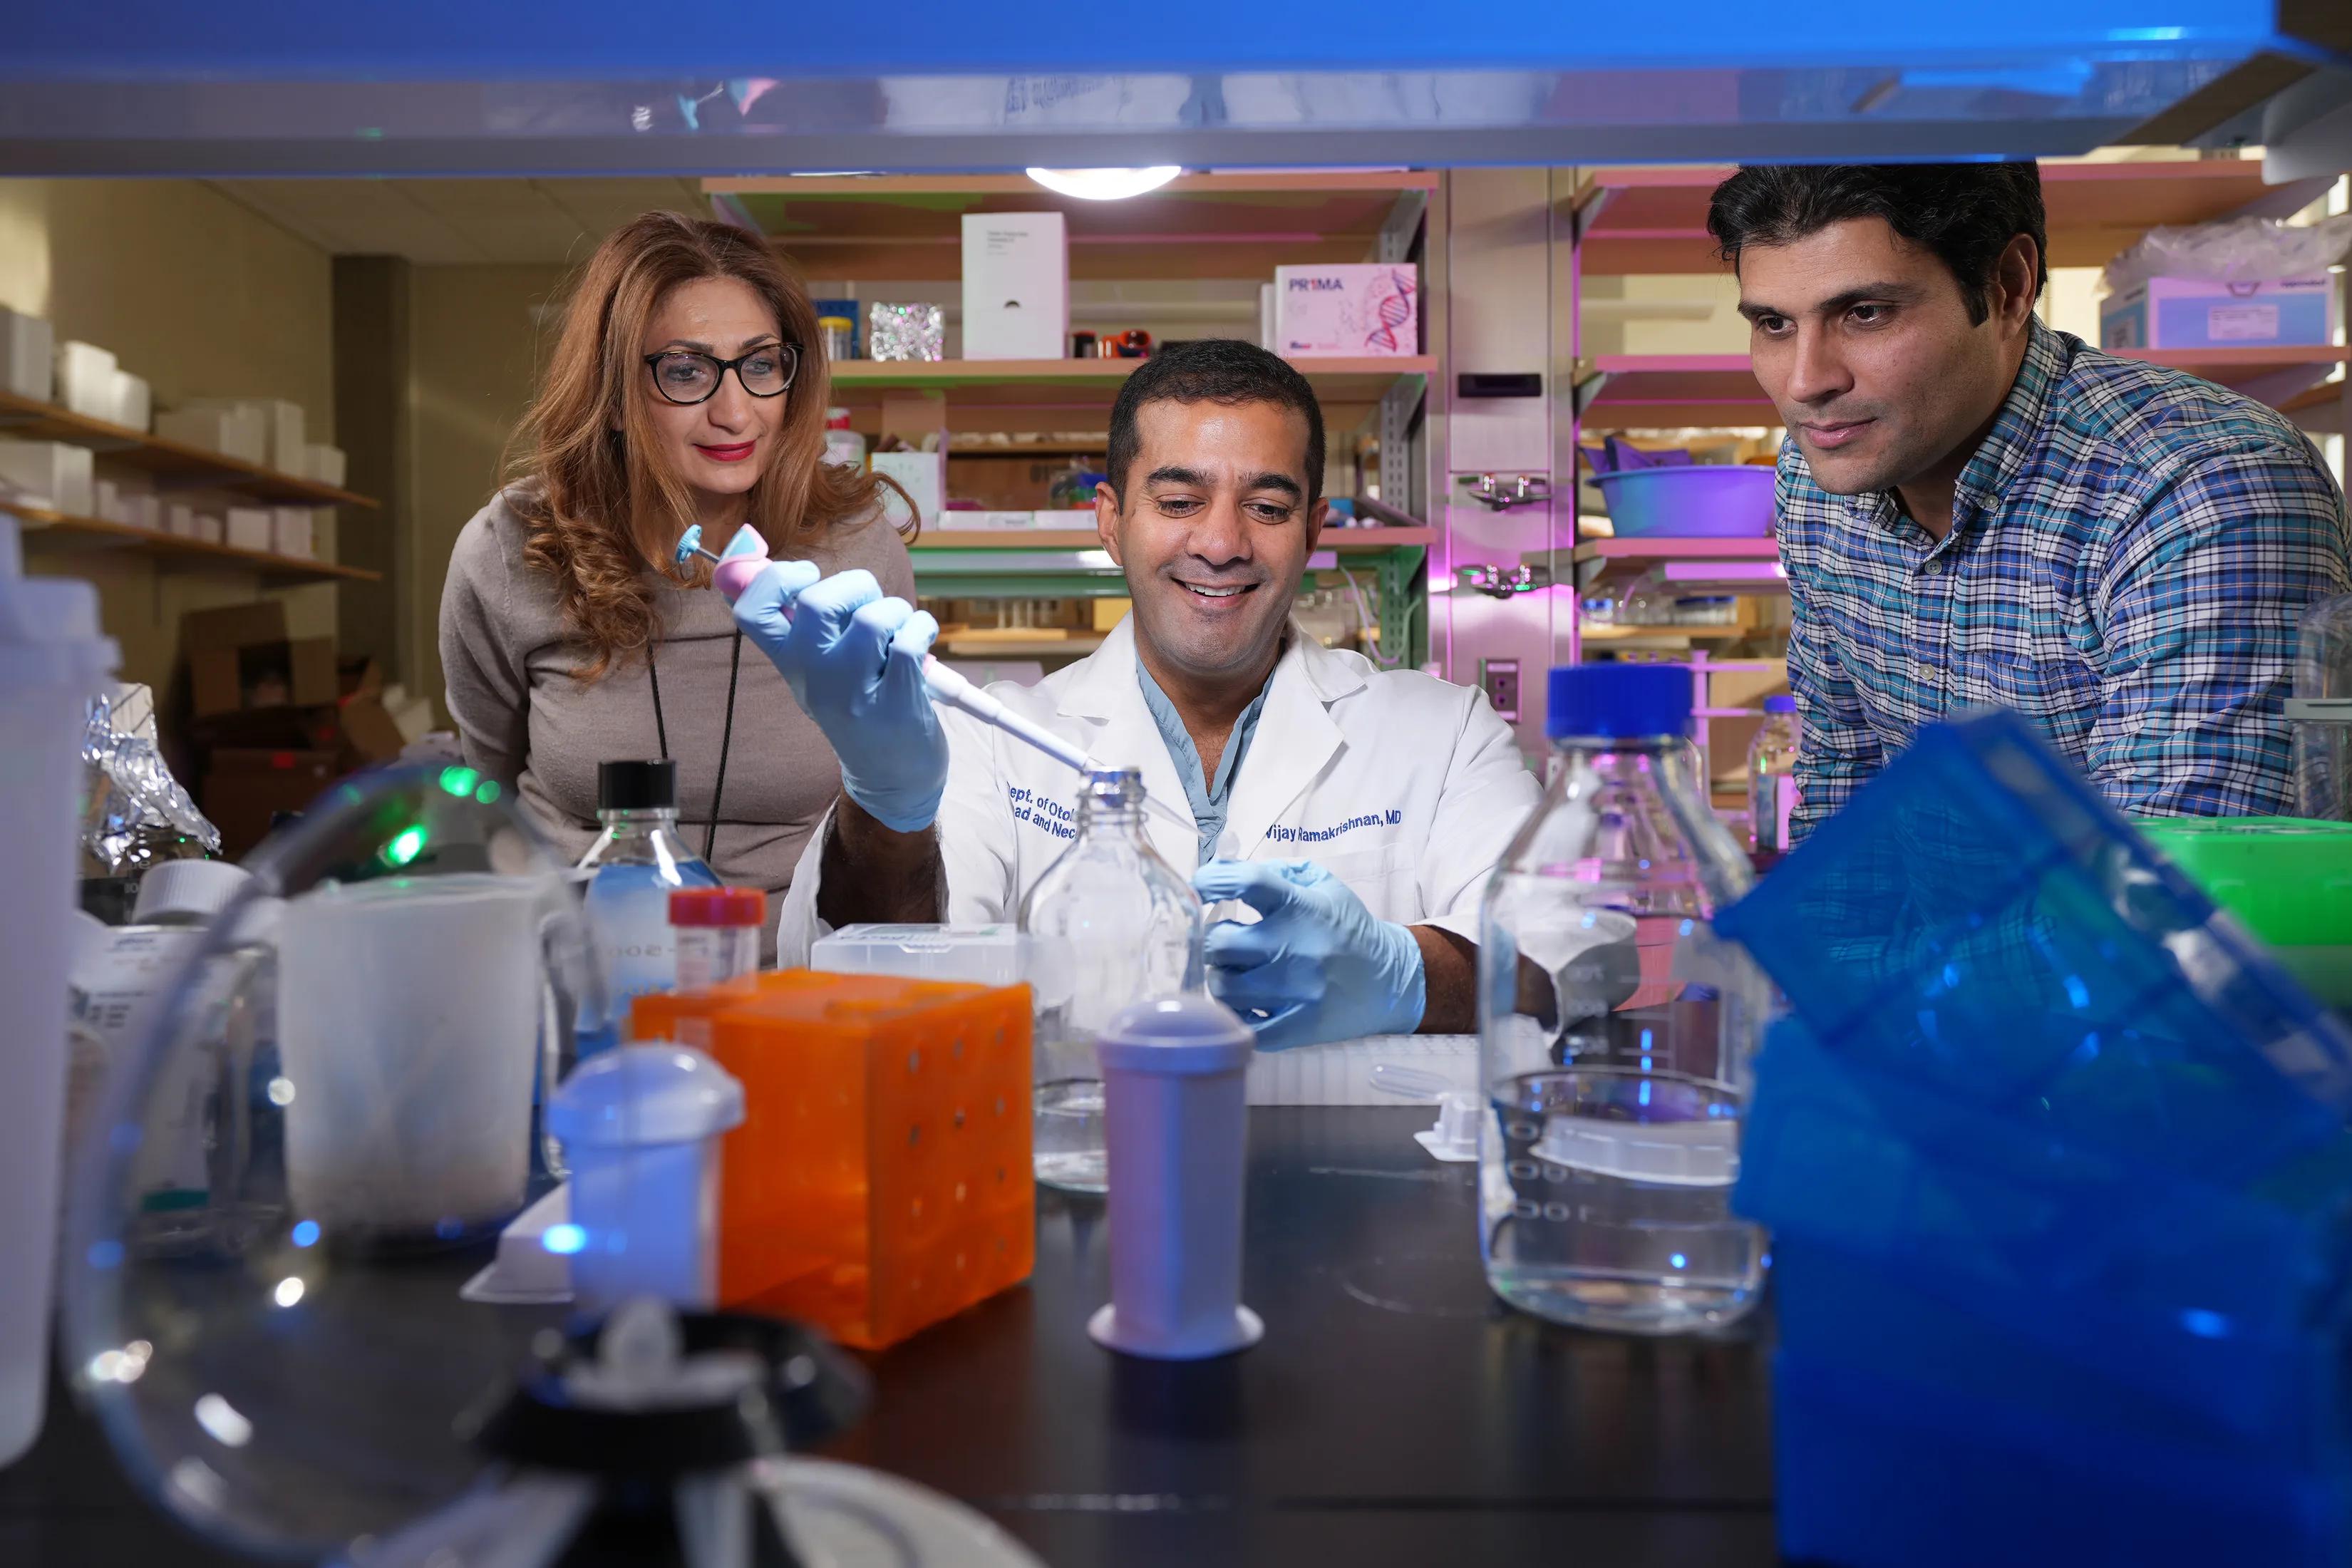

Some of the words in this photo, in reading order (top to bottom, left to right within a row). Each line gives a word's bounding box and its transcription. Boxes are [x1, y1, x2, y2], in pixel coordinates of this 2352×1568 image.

[1009, 784, 1033, 803] ept.
[1037, 797, 1049, 810] of
[1015, 807, 1031, 820] ad
[1033, 813, 1051, 832] and
[1051, 821, 1078, 840] Nec
[1266, 825, 1296, 842] Vijay
[1298, 814, 1383, 842] Ramakrishnan,
[1386, 810, 1402, 825] MD
